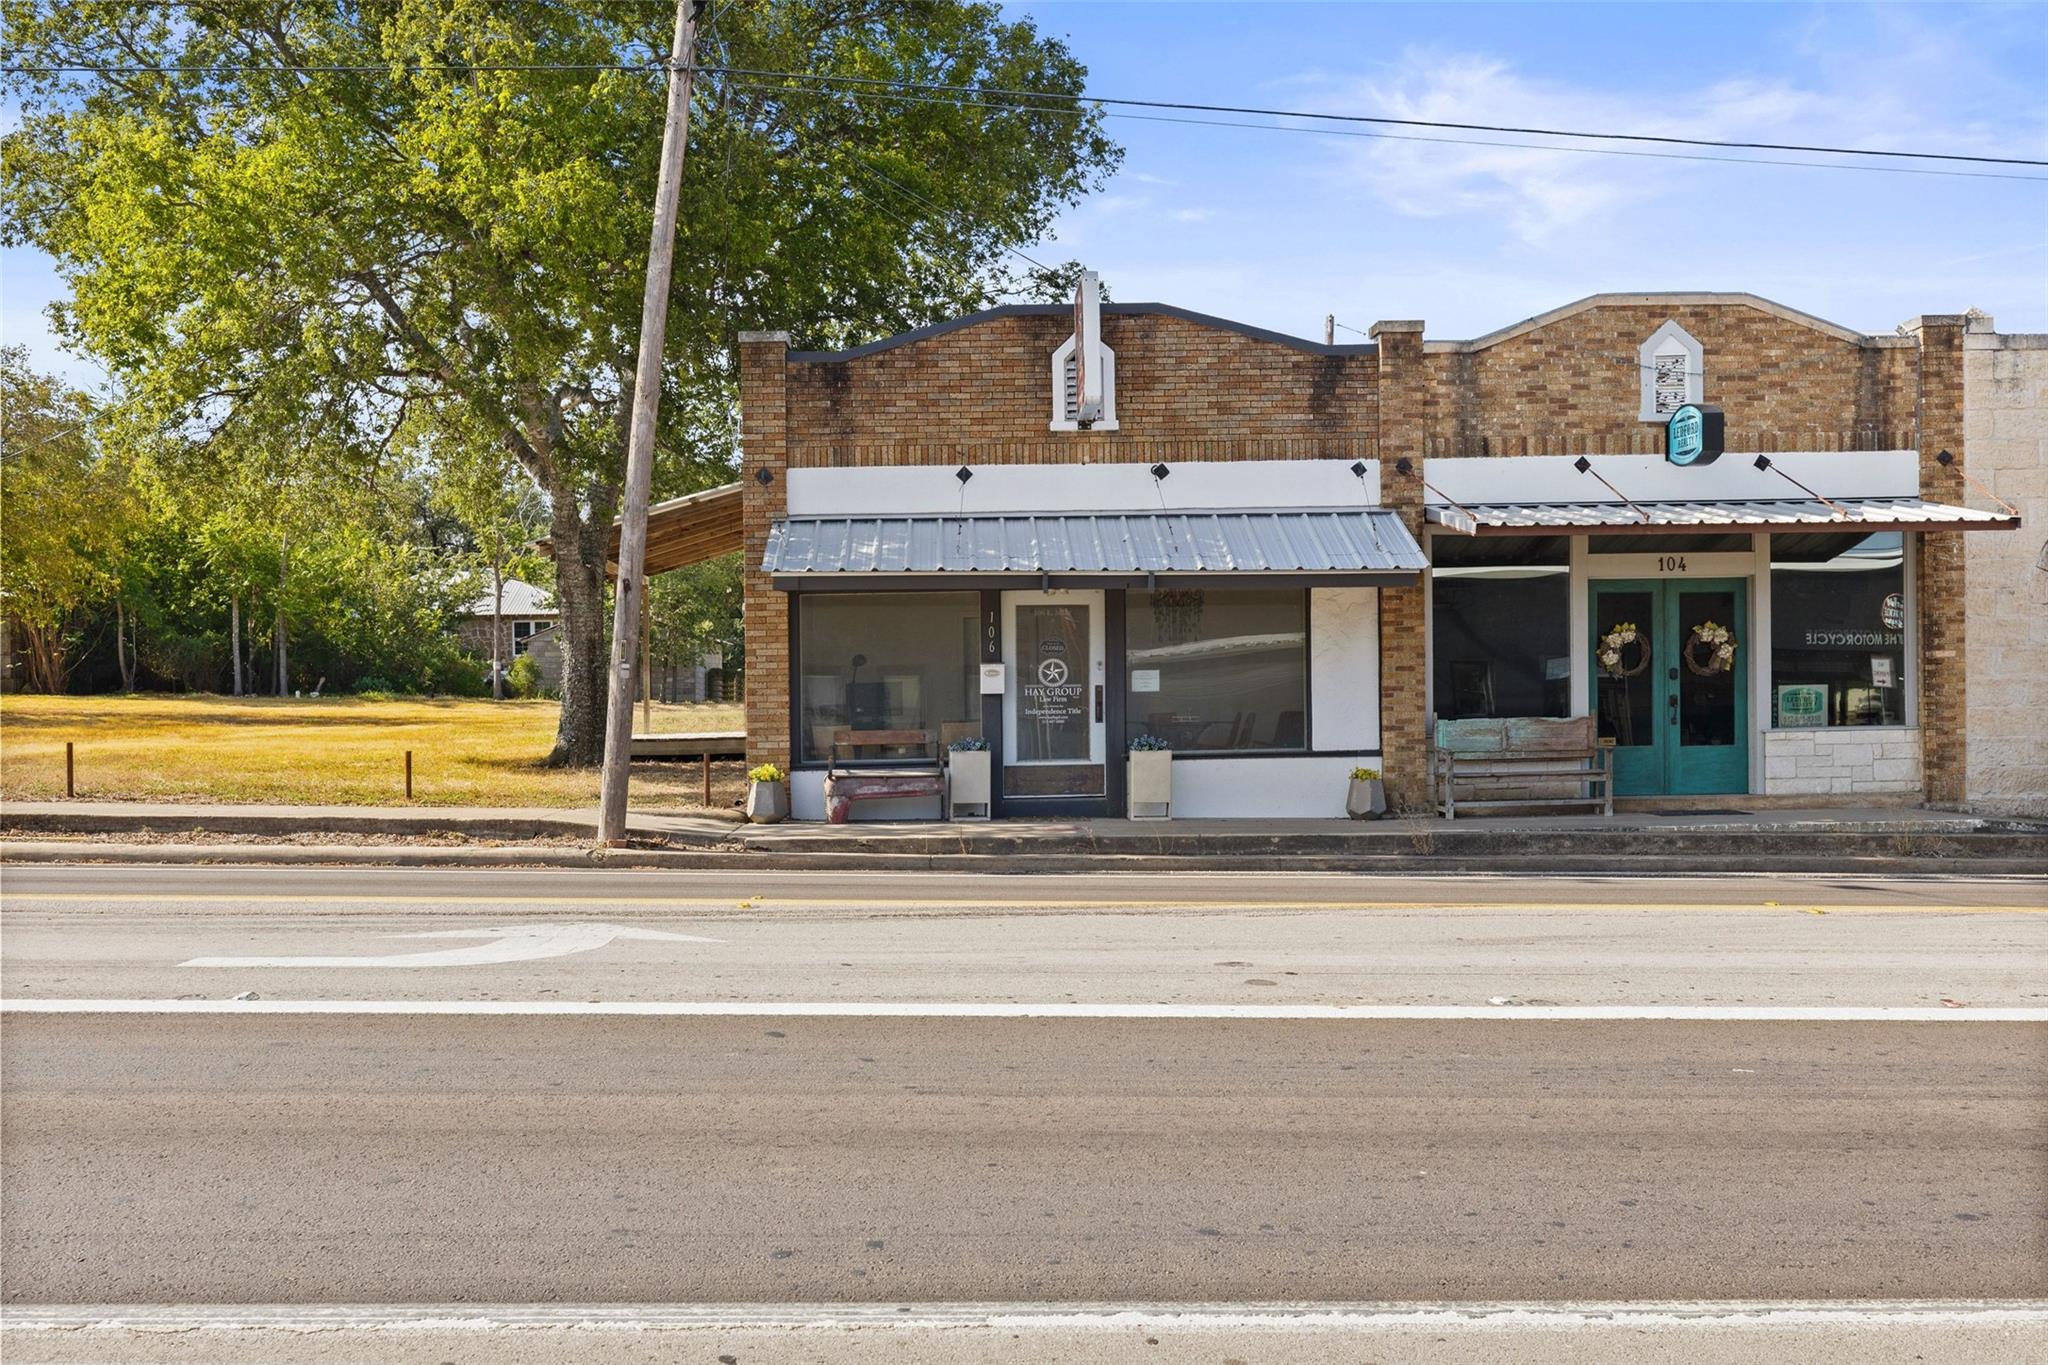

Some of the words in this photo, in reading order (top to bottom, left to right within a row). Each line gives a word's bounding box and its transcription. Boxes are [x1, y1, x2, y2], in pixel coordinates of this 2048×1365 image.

[1673, 421, 1698, 440] LEDFORD
[1658, 556, 1687, 572] 104
[1024, 687, 1045, 696] HAY
[1046, 687, 1082, 696] GROUP
[1025, 708, 1067, 716] Independence
